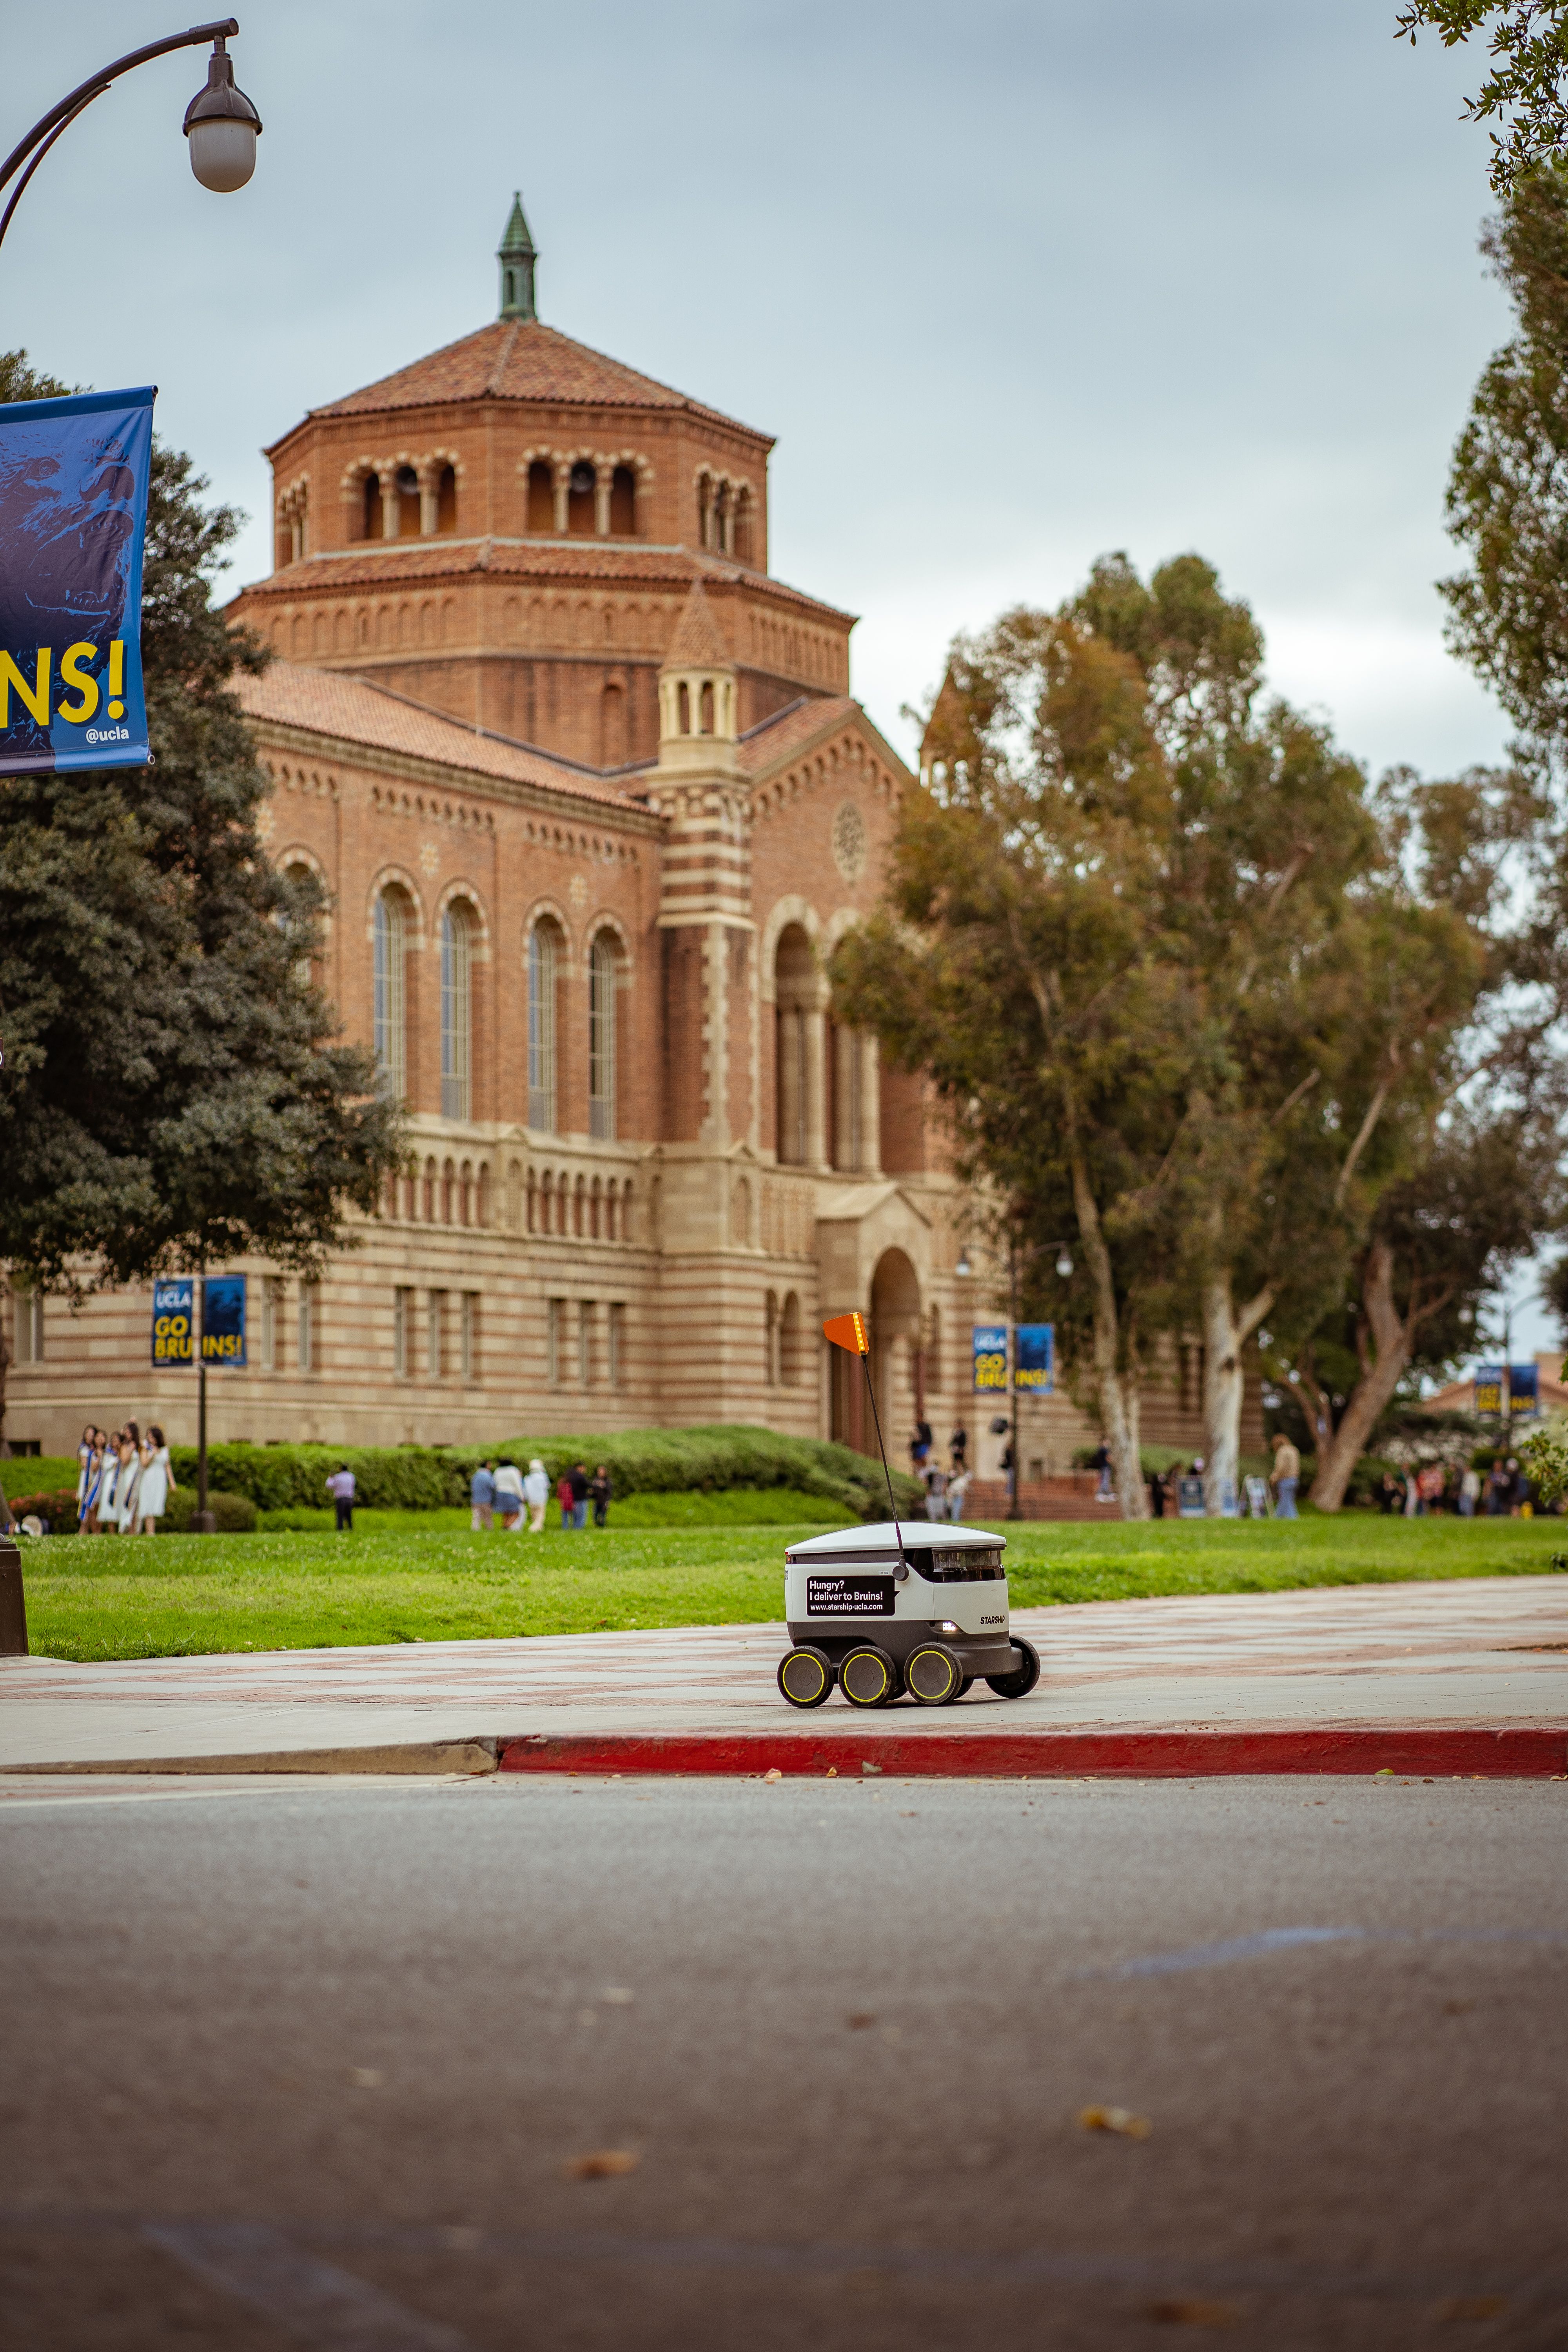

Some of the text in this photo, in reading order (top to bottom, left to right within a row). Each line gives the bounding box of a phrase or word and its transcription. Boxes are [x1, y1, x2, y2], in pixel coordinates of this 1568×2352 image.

[0, 640, 124, 728] NS!
[86, 726, 129, 744] @ucla
[156, 1291, 192, 1308] UCLA
[155, 1315, 189, 1337] GO
[810, 1580, 844, 1591] Hungry?
[810, 1592, 812, 1601] I
[814, 1592, 842, 1601] deliver
[854, 1592, 883, 1600] Bruins!
[810, 1603, 883, 1612] www.starship-ucla.com
[980, 1615, 1005, 1624] STARSHIP
